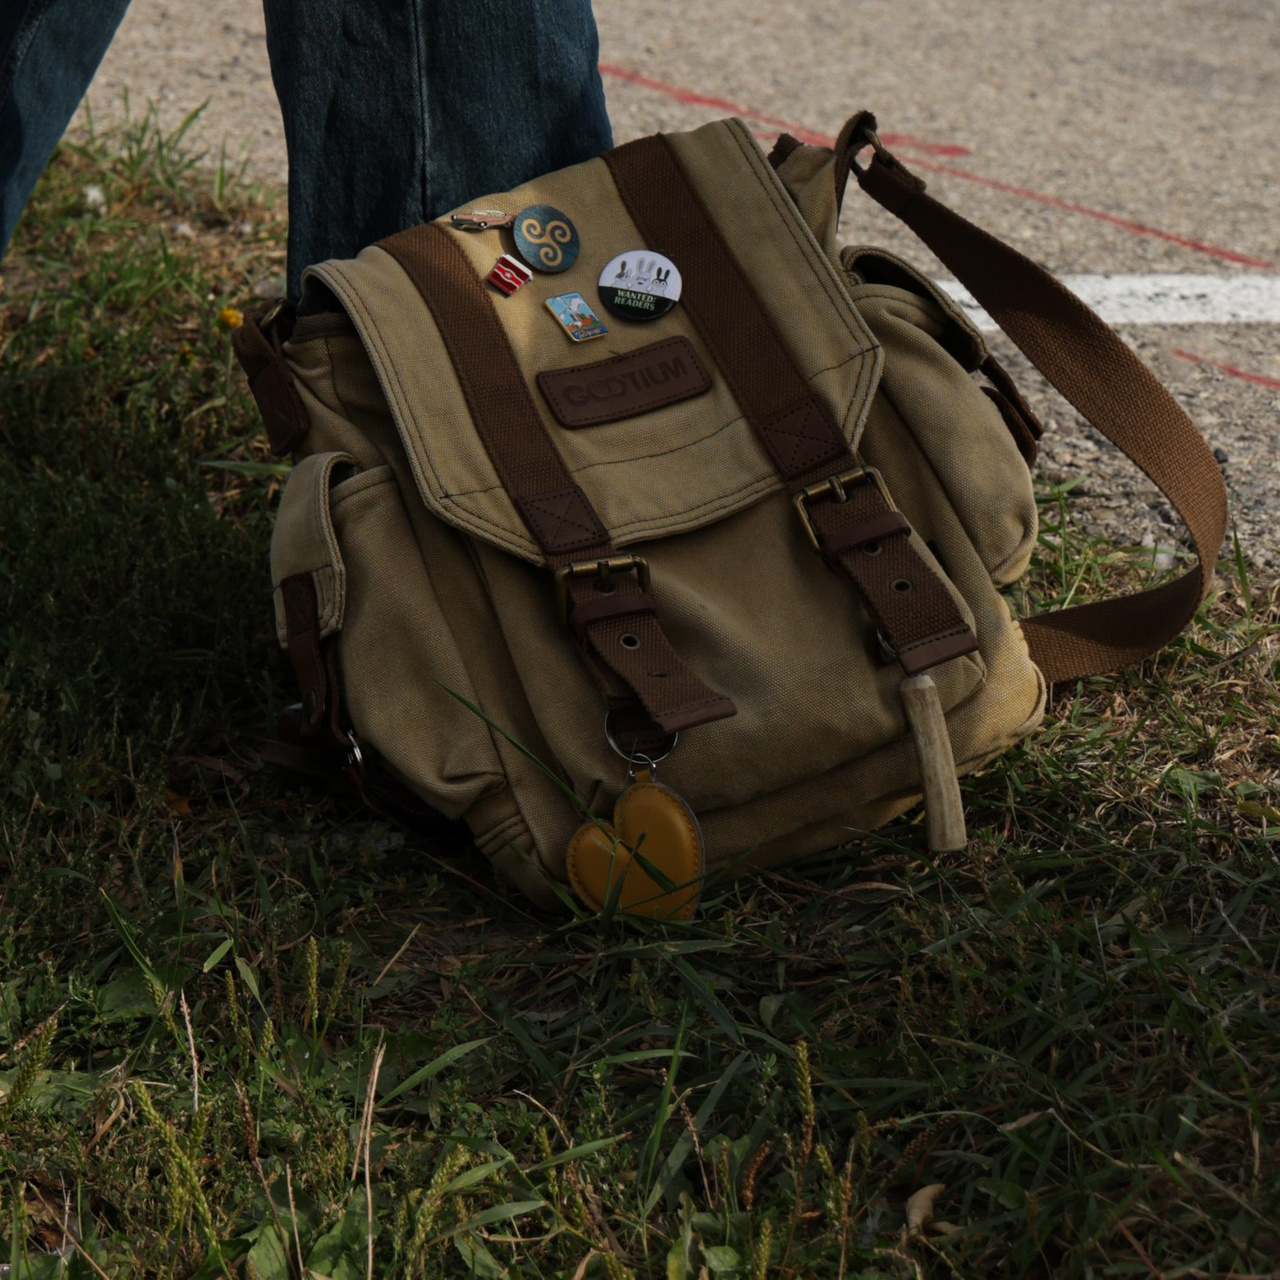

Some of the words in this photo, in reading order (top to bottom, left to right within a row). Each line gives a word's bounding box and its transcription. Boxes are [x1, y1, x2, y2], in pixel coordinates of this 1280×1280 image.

[617, 289, 657, 302] WANTED:
[614, 296, 655, 310] READERS
[564, 357, 688, 406] GOOTIUM
